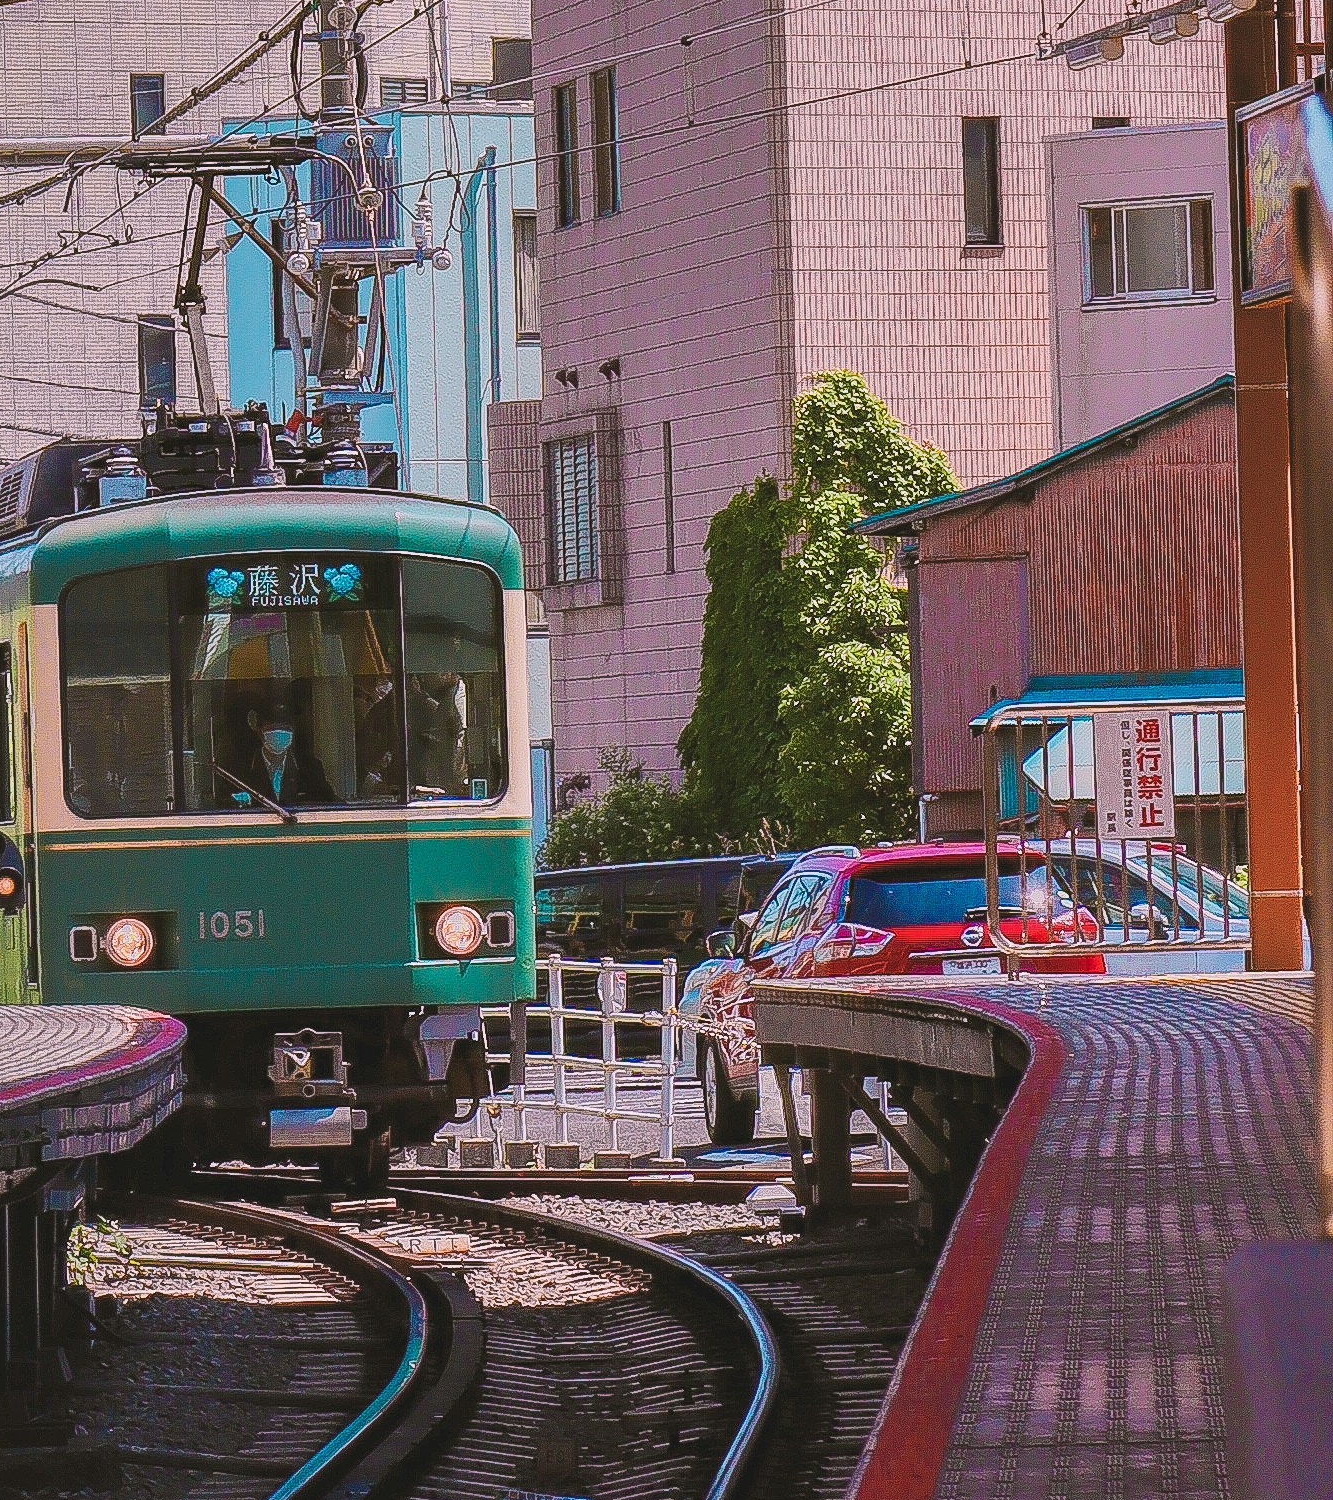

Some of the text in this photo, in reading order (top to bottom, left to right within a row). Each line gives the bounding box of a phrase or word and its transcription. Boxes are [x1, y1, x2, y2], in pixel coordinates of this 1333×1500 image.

[247, 563, 321, 597] 藤沢
[251, 595, 319, 606] FUJISAWA
[1135, 718, 1165, 828] 通行禁止
[199, 909, 265, 939] 1051
